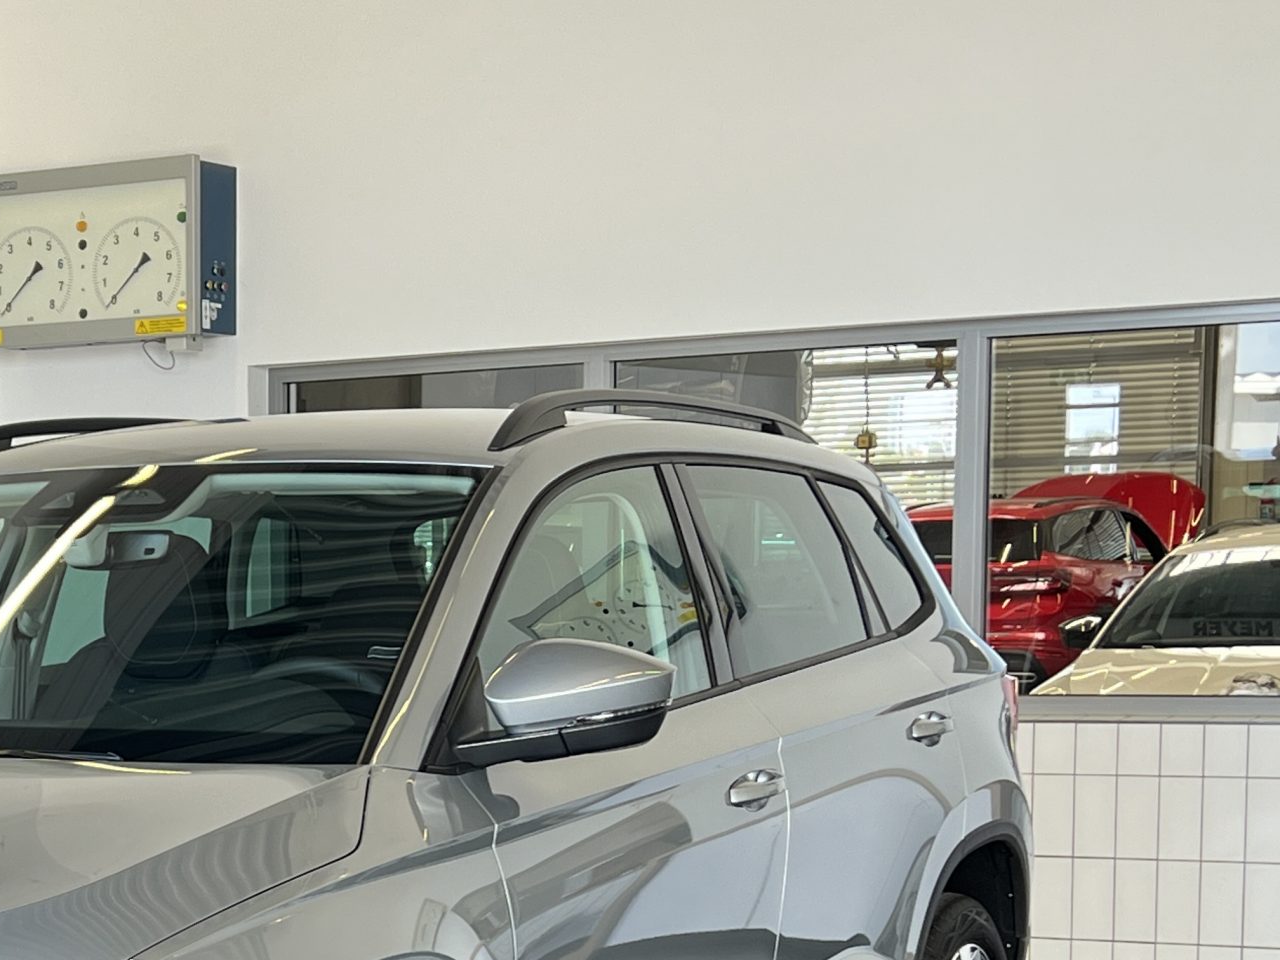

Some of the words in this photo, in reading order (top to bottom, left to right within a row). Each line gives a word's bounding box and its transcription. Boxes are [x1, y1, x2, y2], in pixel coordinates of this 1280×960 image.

[133, 227, 139, 237] 4
[153, 231, 160, 242] 5
[27, 236, 33, 246] 4
[113, 234, 120, 245] 3
[7, 244, 14, 254] 3
[46, 241, 52, 251] 5
[102, 255, 109, 265] 2
[166, 250, 172, 260] 6
[57, 258, 64, 269] 6
[102, 278, 107, 288] 1
[166, 273, 173, 283] 7
[58, 280, 64, 291] 7
[156, 291, 163, 302] 8
[49, 299, 56, 310] 8
